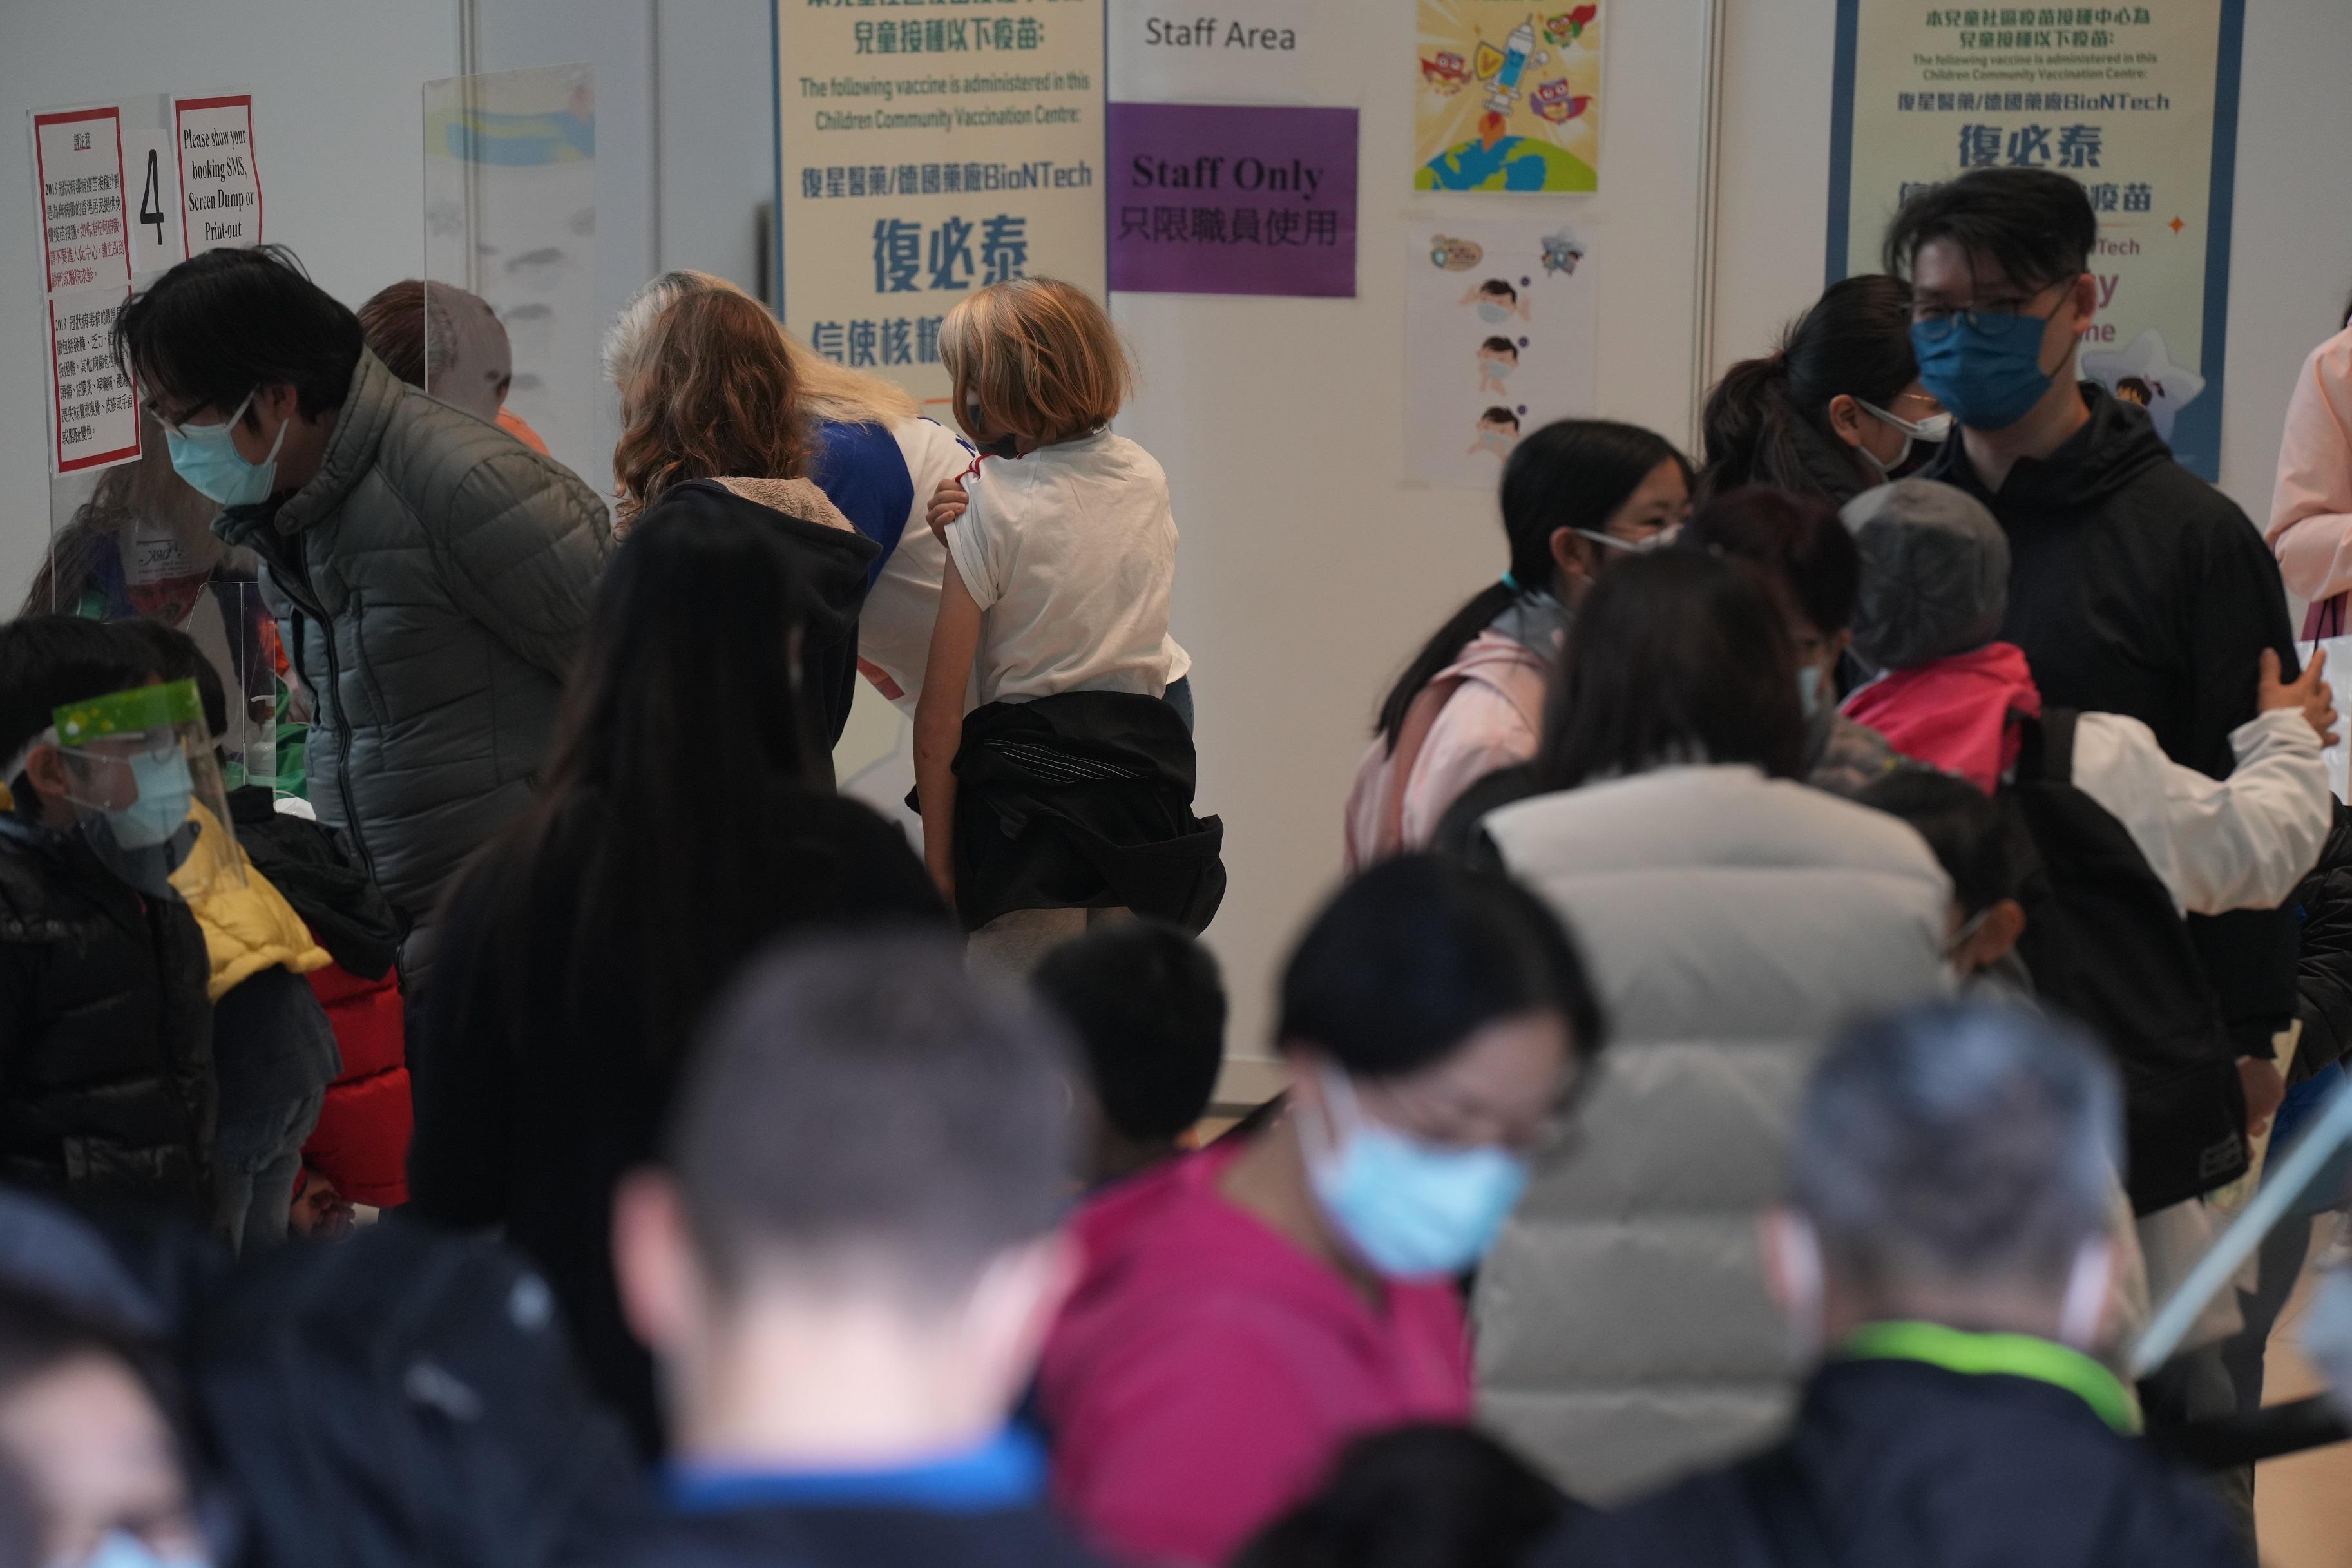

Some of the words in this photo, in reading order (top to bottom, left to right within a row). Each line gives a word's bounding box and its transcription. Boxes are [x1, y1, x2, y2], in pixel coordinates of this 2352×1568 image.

[1145, 17, 1217, 47] Staff
[1224, 21, 1296, 50] Area
[1913, 54, 1933, 65] The
[1935, 54, 1987, 68] following
[1991, 55, 2031, 64] vaccine
[2043, 53, 2121, 64] administered
[2123, 53, 2134, 63] in
[2136, 53, 2157, 64] this
[799, 77, 827, 97] The
[830, 76, 892, 100] following
[897, 74, 947, 95] vaccine
[950, 73, 961, 93] is
[963, 71, 1051, 93] administered
[1054, 72, 1065, 90] in
[1067, 71, 1090, 90] this
[1923, 70, 1970, 81] Children
[1972, 69, 2034, 83] Community
[2038, 68, 2103, 80] Vaccination
[816, 110, 873, 131] Children
[875, 108, 953, 132] Community
[955, 105, 1032, 126] Vaccination
[1035, 104, 1081, 124] Centre:
[74, 133, 91, 150] 請注意
[184, 129, 209, 149] Please
[211, 128, 229, 146] show
[231, 129, 246, 150] your
[1958, 123, 2102, 169] 復必泰
[192, 160, 225, 182] booking
[227, 157, 247, 179] SMS,
[1132, 154, 1225, 190] Staff
[1233, 157, 1324, 202] Only
[46, 183, 58, 196] 2019
[140, 149, 164, 245] 4
[189, 191, 216, 211] Screen
[218, 189, 244, 211] Dump
[246, 191, 254, 206] or
[205, 220, 242, 241] Print-out
[1118, 206, 1338, 247] 只限職員使用
[872, 213, 1029, 293] 復必泰
[2097, 237, 2140, 255] Tech
[56, 318, 67, 332] 2019
[812, 316, 944, 367] 信使核糖
